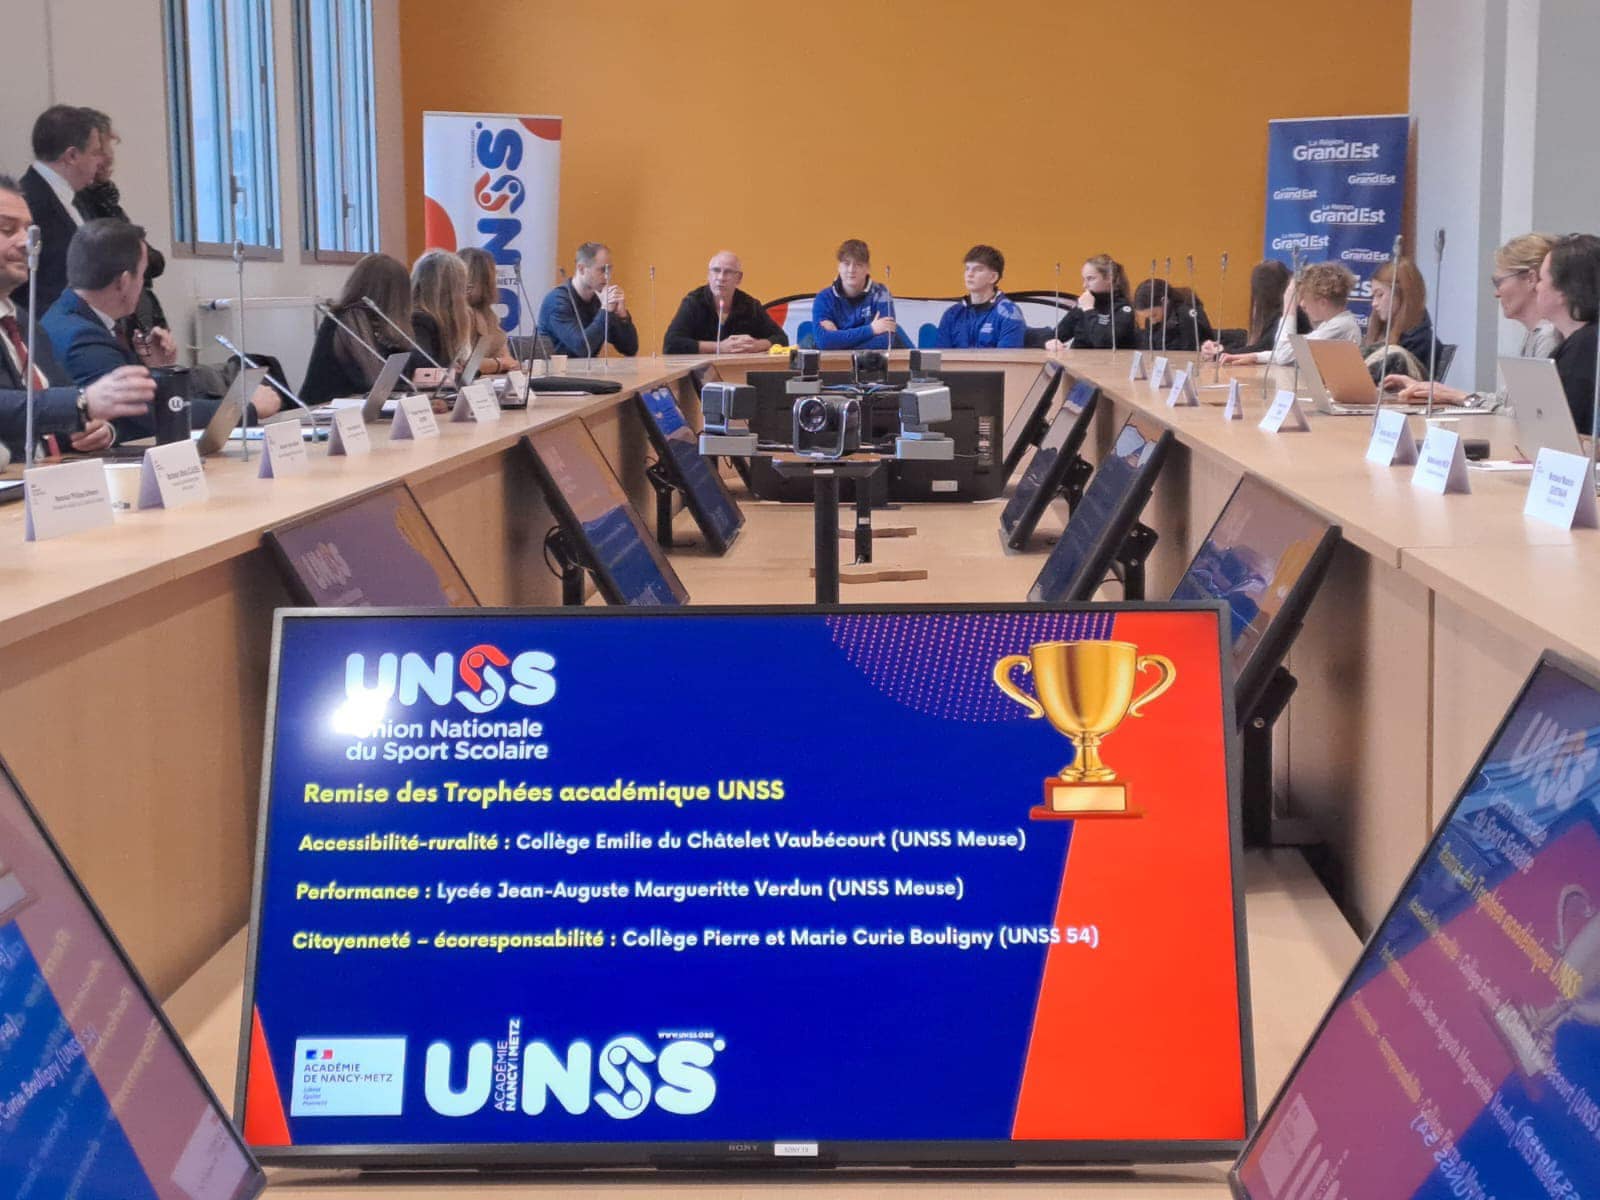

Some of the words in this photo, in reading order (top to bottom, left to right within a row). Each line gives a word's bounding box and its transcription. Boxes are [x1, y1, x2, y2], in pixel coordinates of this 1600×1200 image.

[345, 645, 557, 714] UNSS
[430, 718, 544, 739] Nationale
[345, 741, 377, 761] du
[382, 741, 449, 764] Sport
[454, 740, 549, 760] Scolaire
[303, 781, 391, 803] Remise
[396, 780, 438, 803] des
[444, 779, 552, 809] Trophées
[559, 778, 711, 808] académique
[718, 780, 785, 801] UNSS
[298, 831, 498, 852] Accessibilité-ruralité
[515, 832, 590, 855] Collège
[596, 830, 652, 849] Emilie
[658, 831, 681, 849] du
[687, 830, 770, 849] Châtelet
[775, 829, 886, 849] Vaubécourt
[891, 829, 952, 852] (UNSS
[957, 828, 1026, 852] Meuse)
[296, 880, 419, 900] Performance
[437, 881, 492, 904] Lycée
[498, 881, 629, 903] Jean-Auguste
[635, 880, 749, 902] Margueritte
[754, 878, 822, 897] Verdun
[829, 878, 889, 902] (UNSS
[895, 876, 964, 901] Meuse)
[293, 931, 411, 954] Citoyenneté
[434, 928, 604, 952] écoresponsabilité
[623, 927, 697, 951] Collège
[704, 928, 760, 946] Pierre
[766, 929, 786, 946] et
[791, 928, 847, 946] Marie
[853, 928, 905, 946] Curie
[910, 926, 994, 950] Bouligny
[1000, 925, 1061, 950] (UNSS
[1066, 925, 1099, 949] 54)
[303, 1074, 317, 1083] DE
[320, 1073, 393, 1083] NANCY-METZ
[304, 1063, 361, 1073] ACADÉMIE
[424, 1036, 717, 1120] UNSS
[494, 1039, 508, 1111] ACADÉMIE
